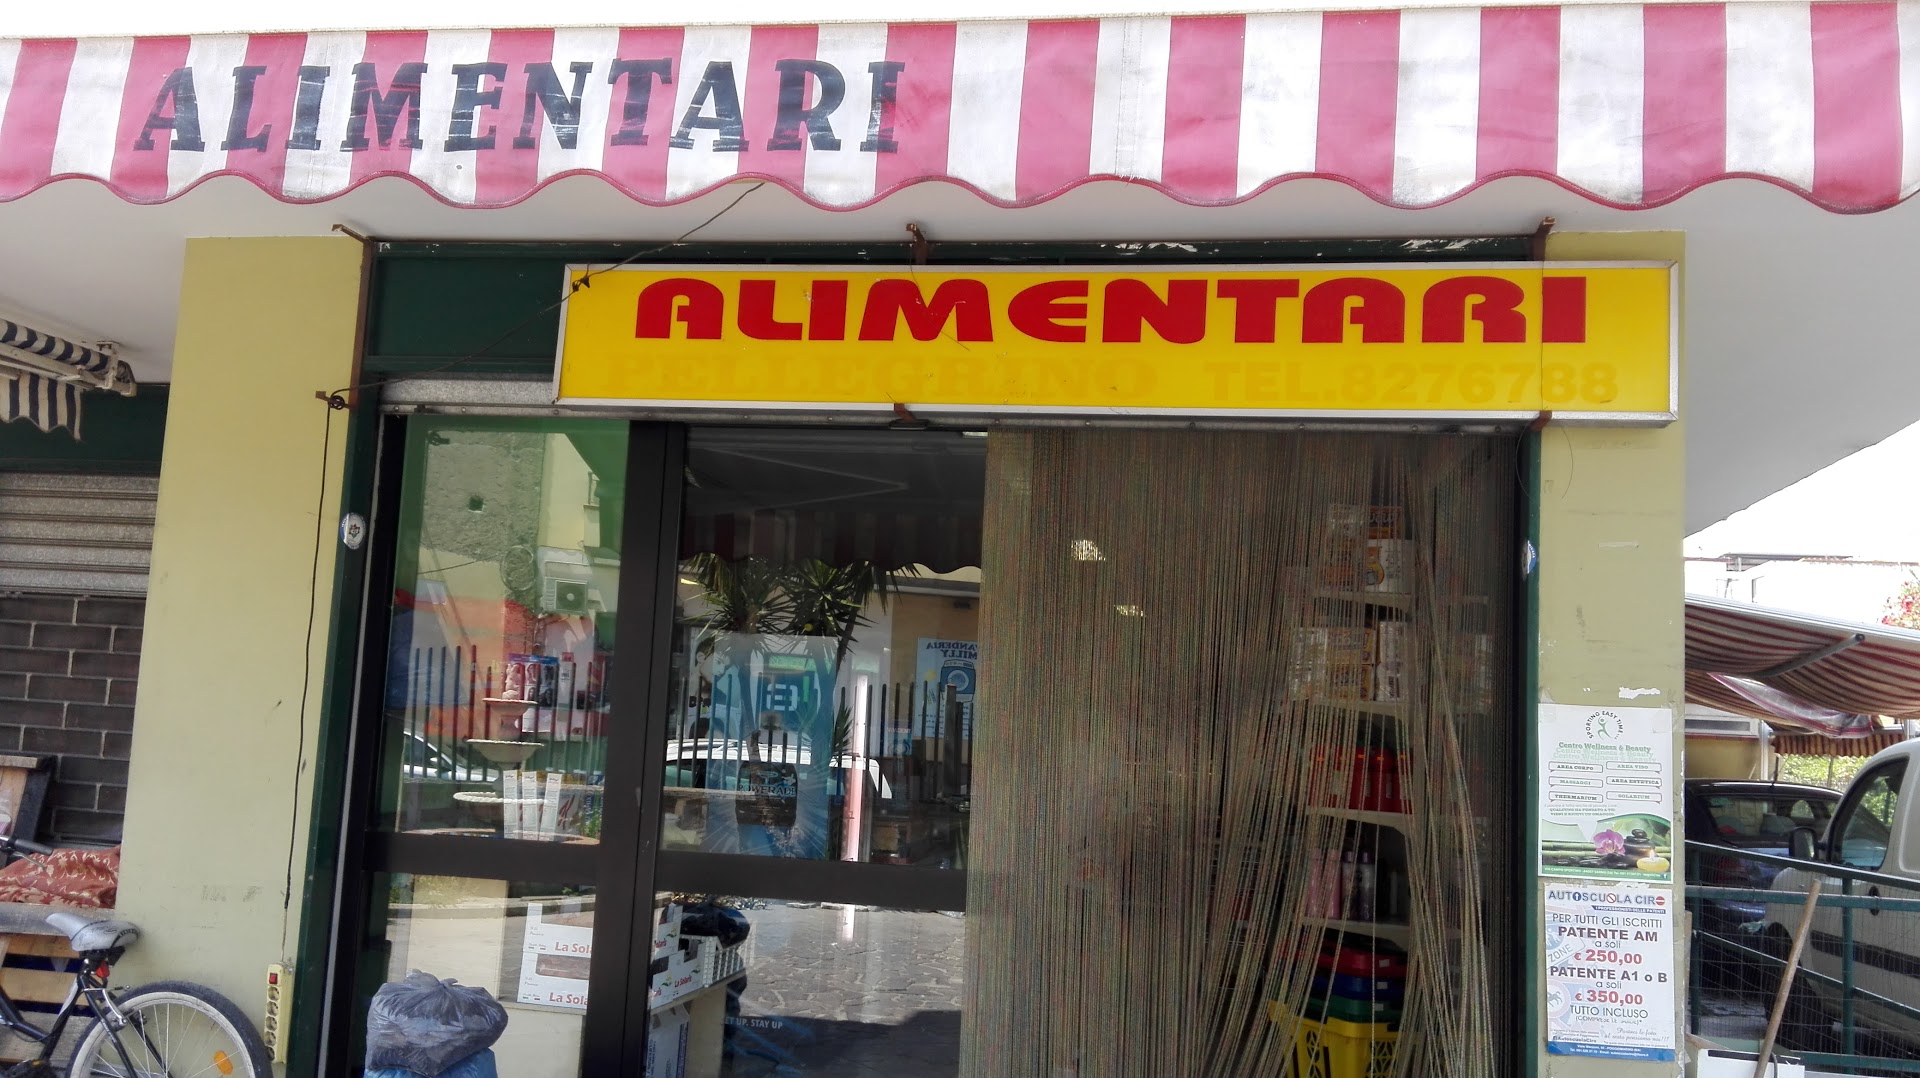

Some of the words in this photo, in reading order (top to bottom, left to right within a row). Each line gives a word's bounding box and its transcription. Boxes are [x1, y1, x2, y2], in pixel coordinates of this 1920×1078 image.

[133, 58, 905, 154] ALIMENTARI
[635, 275, 1586, 342] ALIMENTARI
[598, 351, 1160, 404] PELLEGRINO
[1602, 710, 1618, 719] EASY
[1616, 719, 1624, 733] TIME
[1584, 743, 1617, 751] Wellness
[1625, 745, 1651, 753] Beauty
[1553, 913, 1571, 923] PER
[1574, 915, 1598, 925] TUTTI
[1602, 916, 1619, 926] GLI
[1622, 918, 1662, 928] ISCRITTI
[1558, 926, 1628, 940] PATENTE
[1634, 930, 1658, 942] AM
[555, 941, 568, 952] La
[1605, 940, 1621, 948] soli
[1548, 943, 1573, 963] ZONE
[1574, 952, 1581, 960] €
[1585, 949, 1642, 966] 250,00
[1550, 966, 1616, 980] PATENTE
[1621, 970, 1638, 981] A1
[1644, 974, 1653, 982] o
[1658, 972, 1667, 983] B
[1606, 981, 1622, 989] soli
[549, 992, 563, 1003] La
[1575, 993, 1582, 1001] €
[1587, 990, 1643, 1006] 350,00
[1570, 1005, 1599, 1016] TUTTO
[1603, 1007, 1648, 1018] INCLUSO
[736, 1017, 749, 1027] UP.
[751, 1019, 769, 1028] STAY
[771, 1021, 783, 1029] UP
